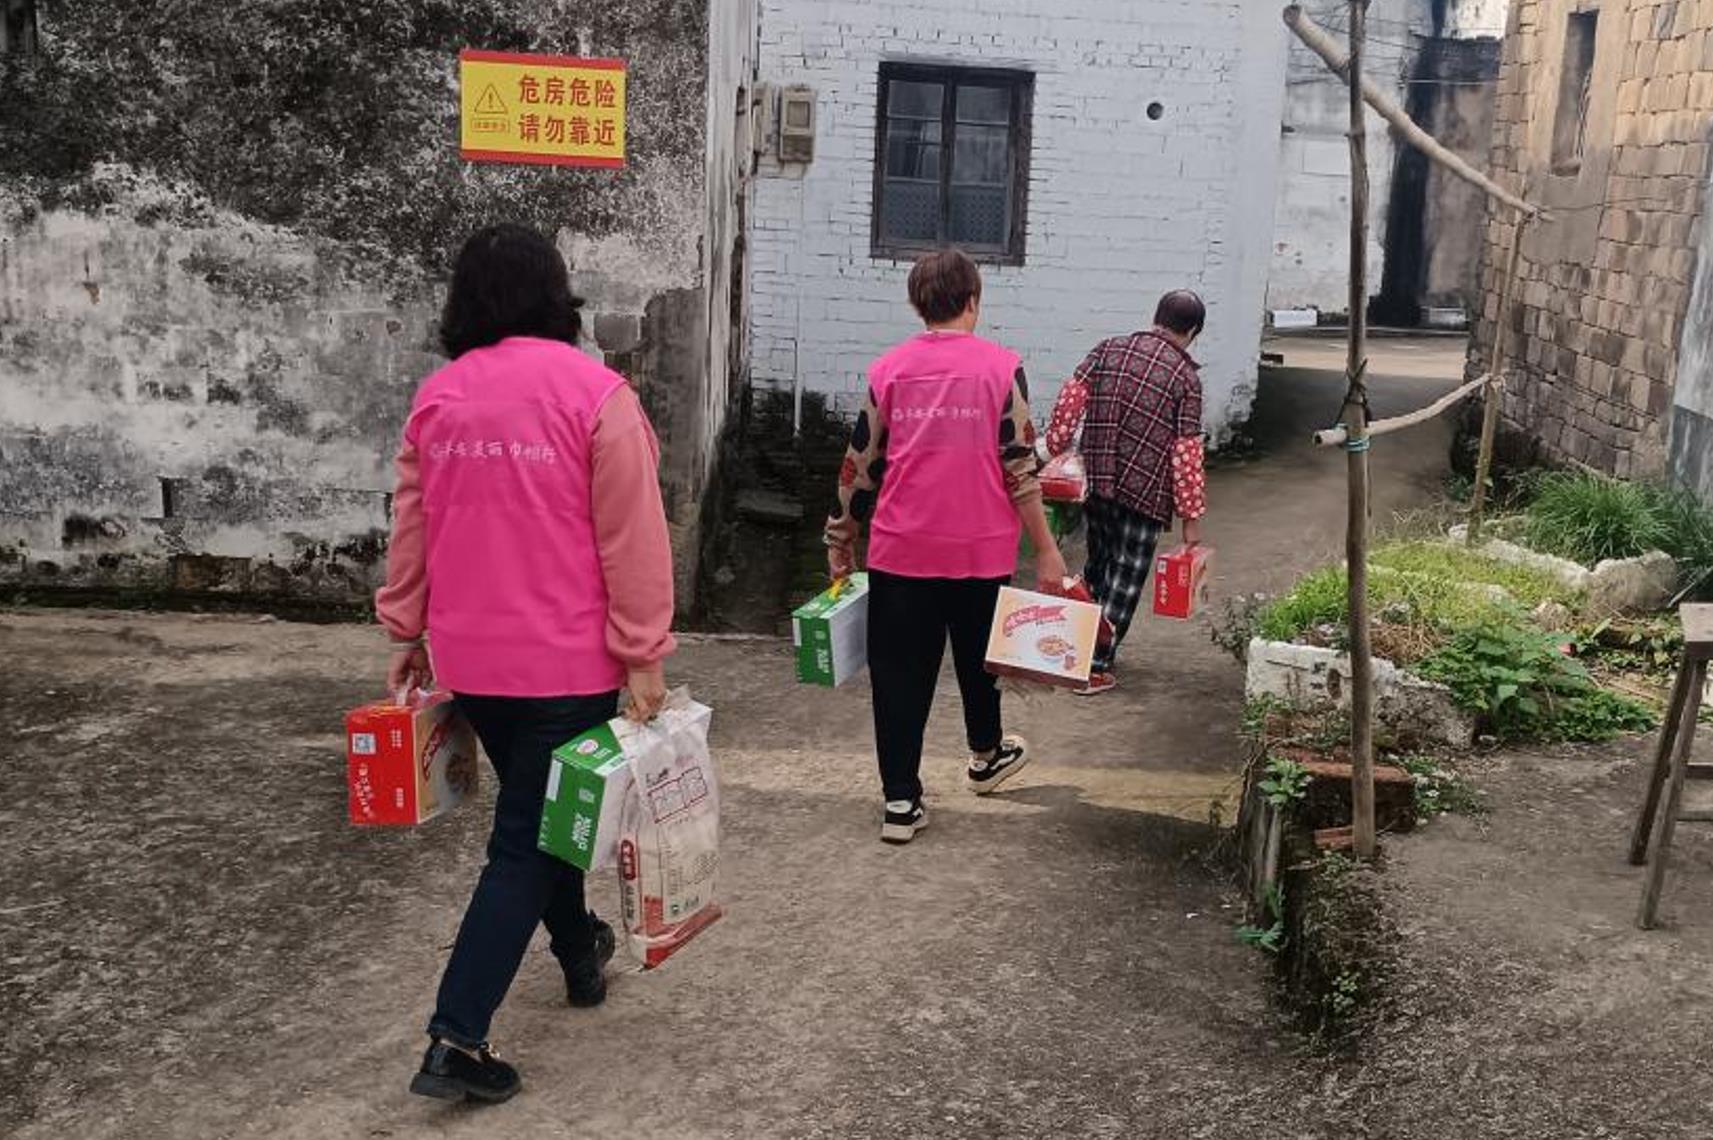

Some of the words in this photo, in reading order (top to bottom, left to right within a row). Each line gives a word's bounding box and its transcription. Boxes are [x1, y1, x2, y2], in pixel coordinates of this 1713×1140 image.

[518, 74, 615, 108] 危房危险
[518, 113, 616, 146] 请勿靠近
